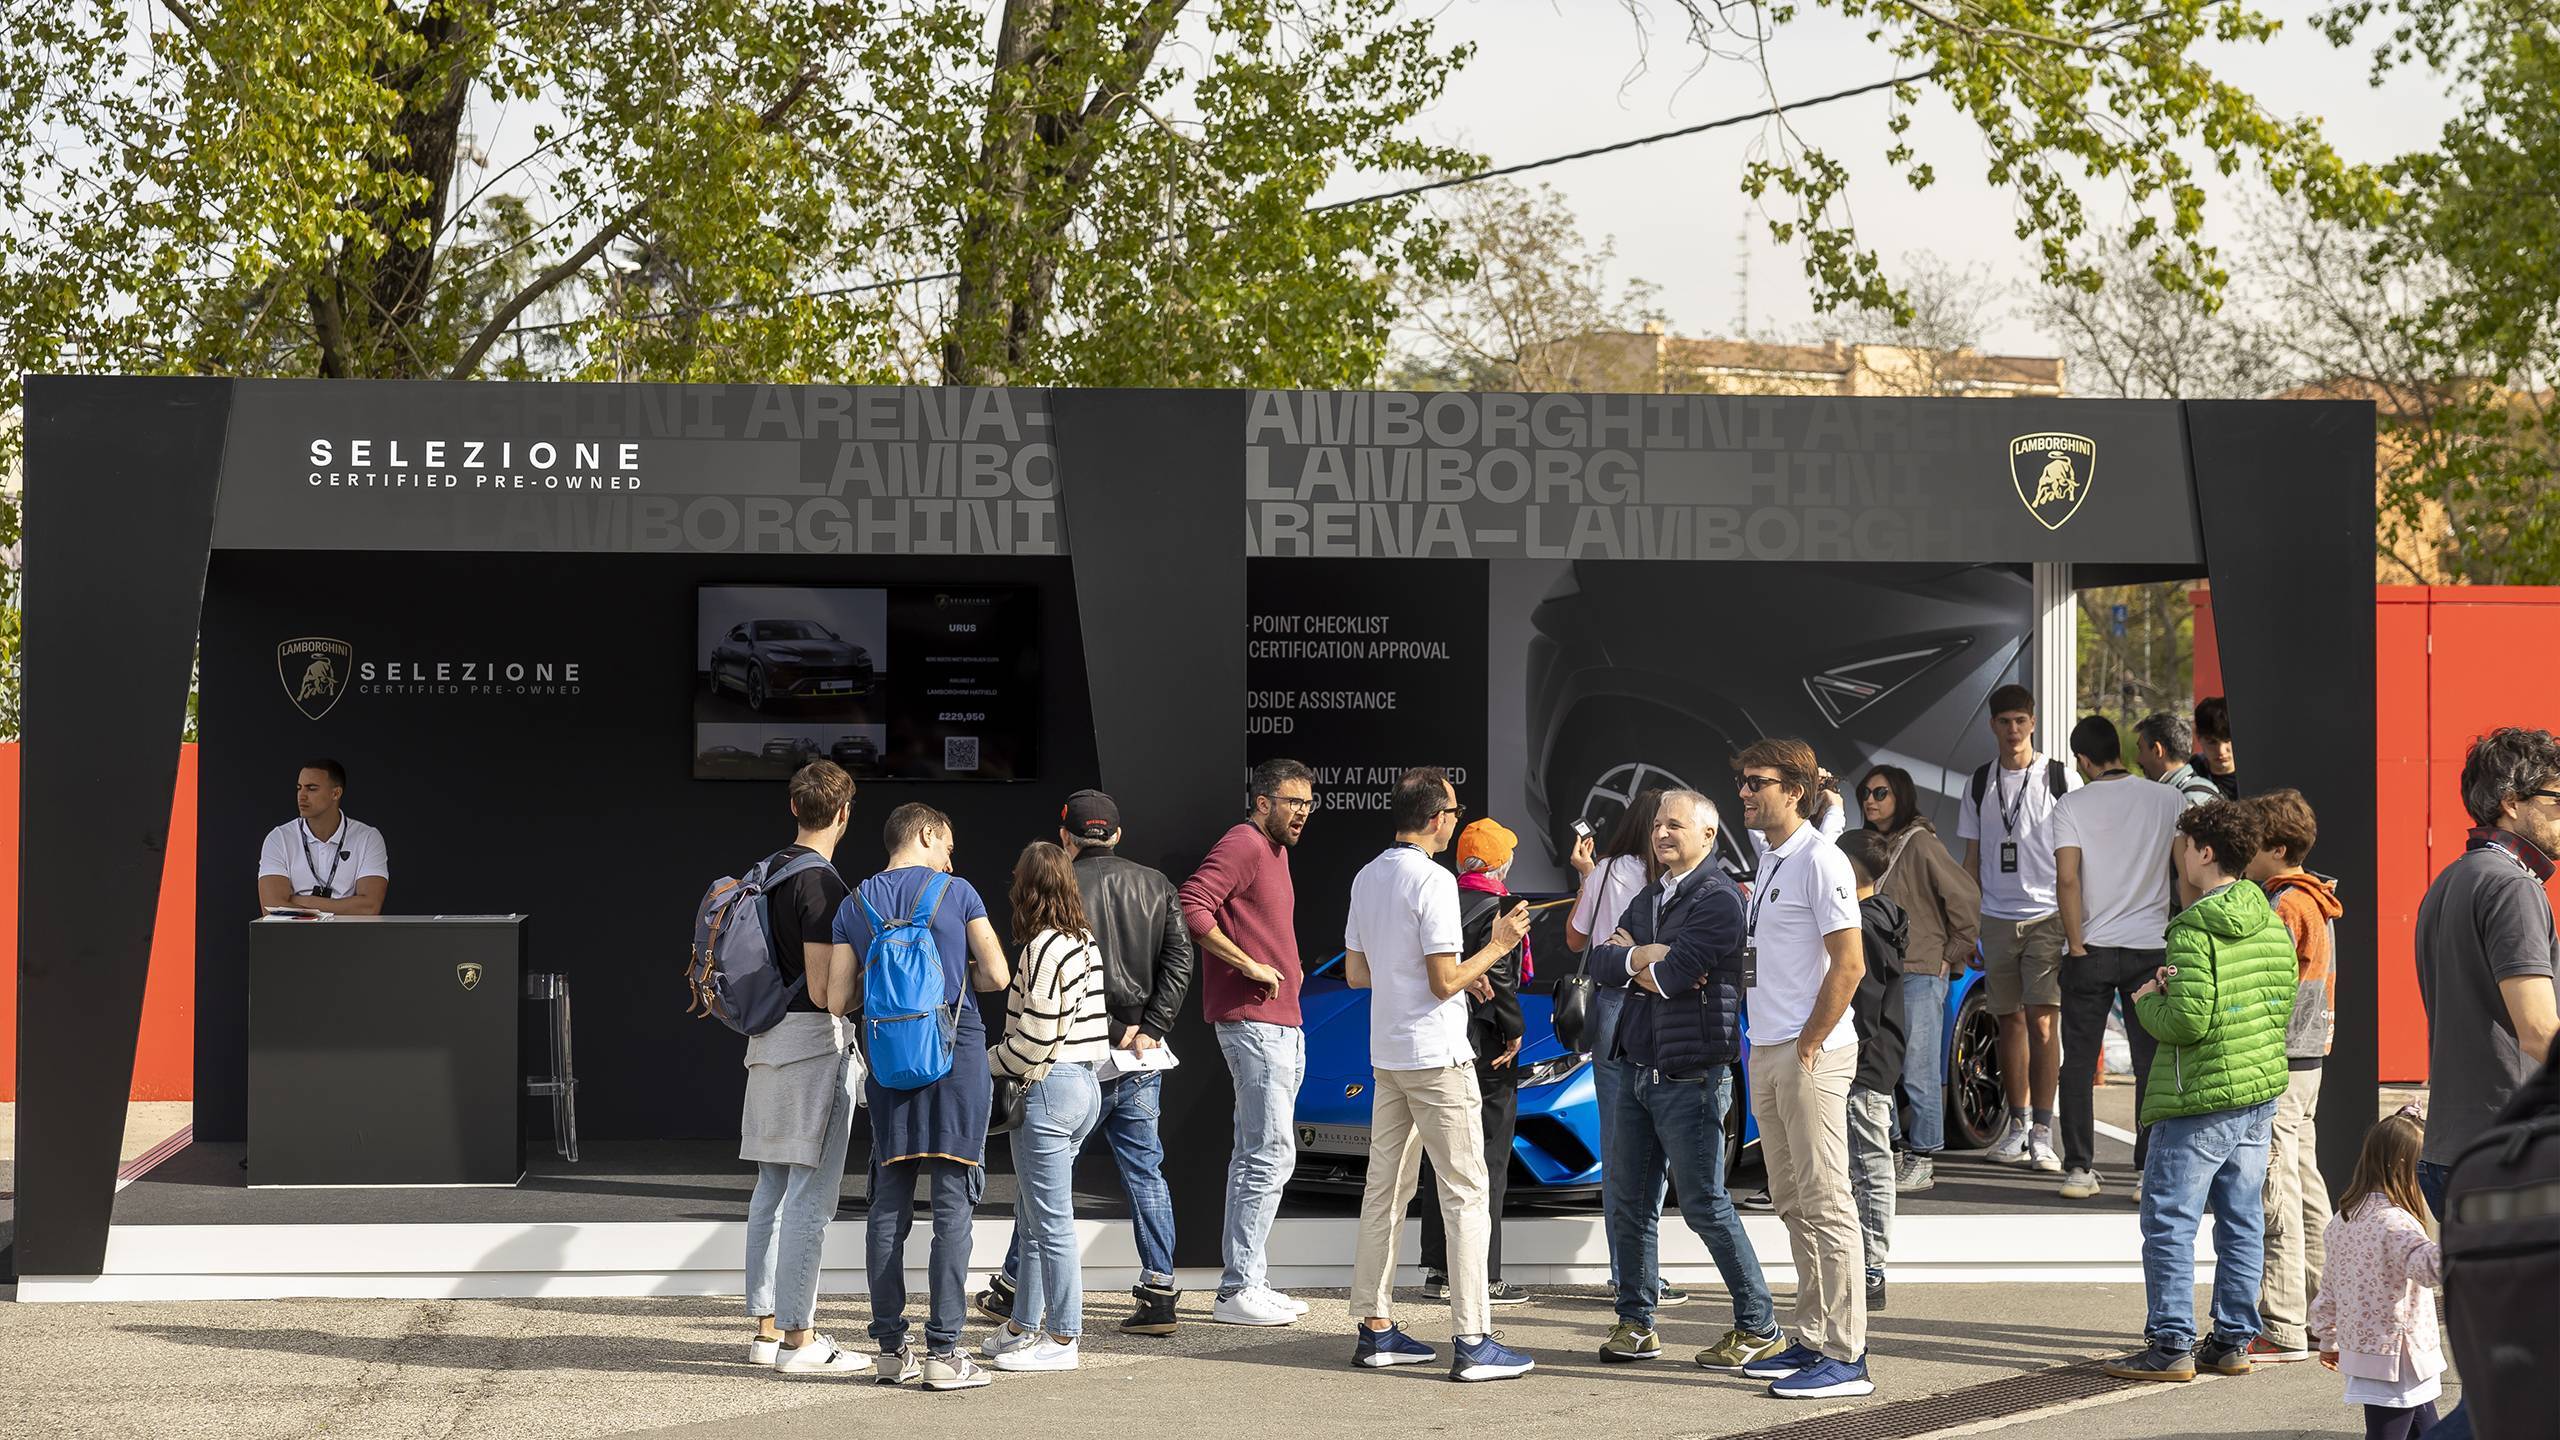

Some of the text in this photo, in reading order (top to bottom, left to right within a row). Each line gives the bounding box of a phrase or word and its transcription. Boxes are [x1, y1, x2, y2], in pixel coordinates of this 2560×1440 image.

[309, 438, 641, 472] SELEZIONE
[2015, 436, 2091, 456] LAMBORGHINI
[309, 472, 641, 490] CERTIFIED PRE-OWNED
[948, 623, 977, 633] URUS
[1304, 616, 1390, 634] CHECKLIST
[281, 640, 348, 657] LAMBORGHINI
[1249, 640, 1450, 660] CERTIFICATION APPROVAL
[359, 661, 580, 682] SELEZIONE
[359, 684, 582, 696] CERTIFIED PRE-OWNED
[1298, 690, 1397, 710] ASSISTANCE
[938, 711, 985, 723] £229,950
[1311, 766, 1341, 785] NLY
[1345, 766, 1364, 785] AT
